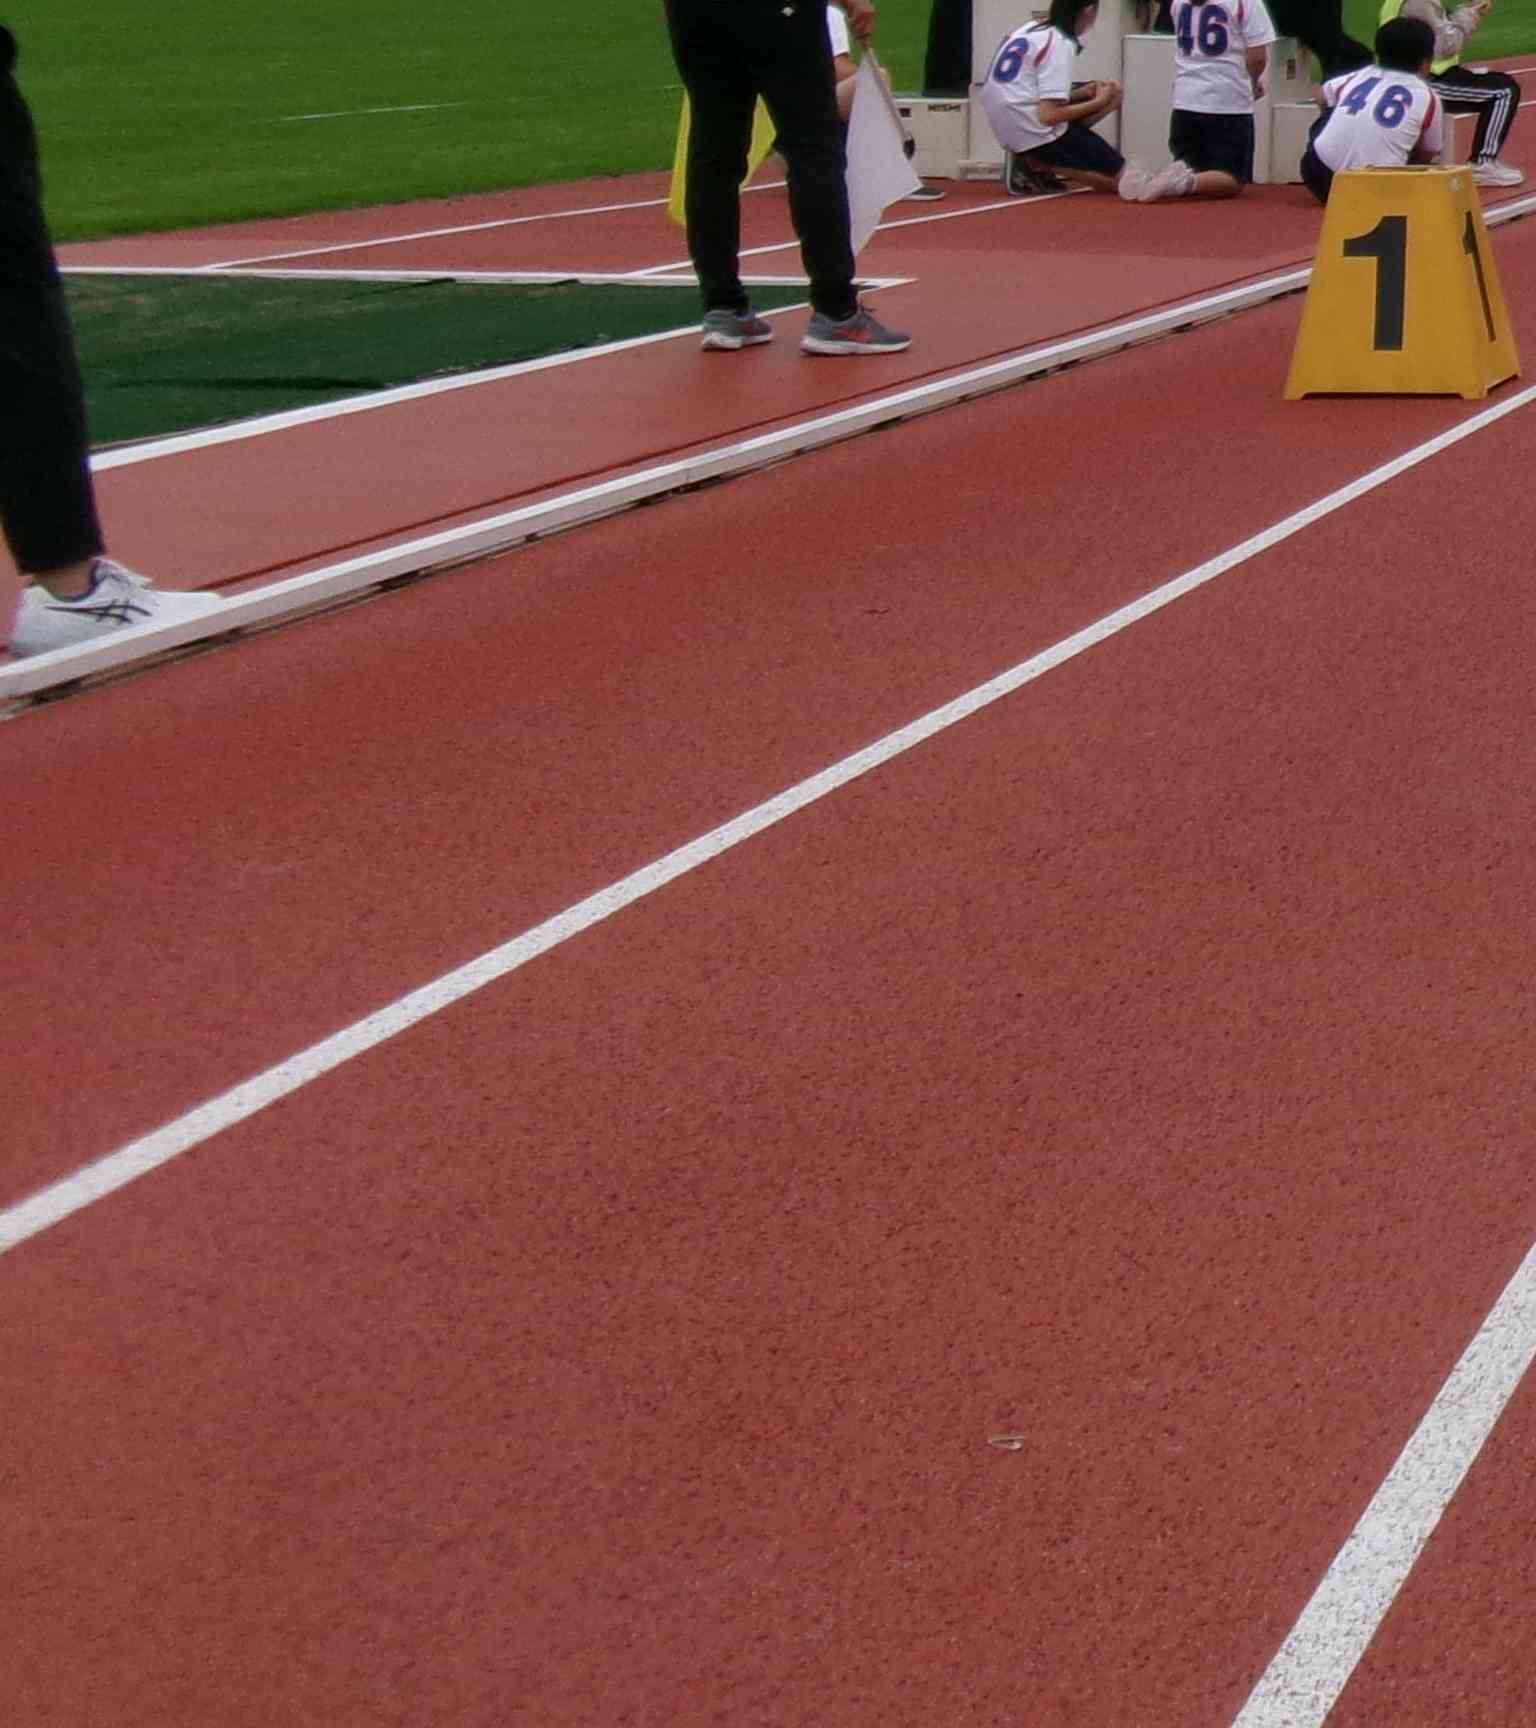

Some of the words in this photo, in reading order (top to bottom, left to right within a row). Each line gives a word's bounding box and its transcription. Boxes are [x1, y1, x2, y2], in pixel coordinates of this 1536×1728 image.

[1177, 3, 1229, 56] 46
[1340, 76, 1414, 129] 46
[1342, 215, 1408, 351] 1
